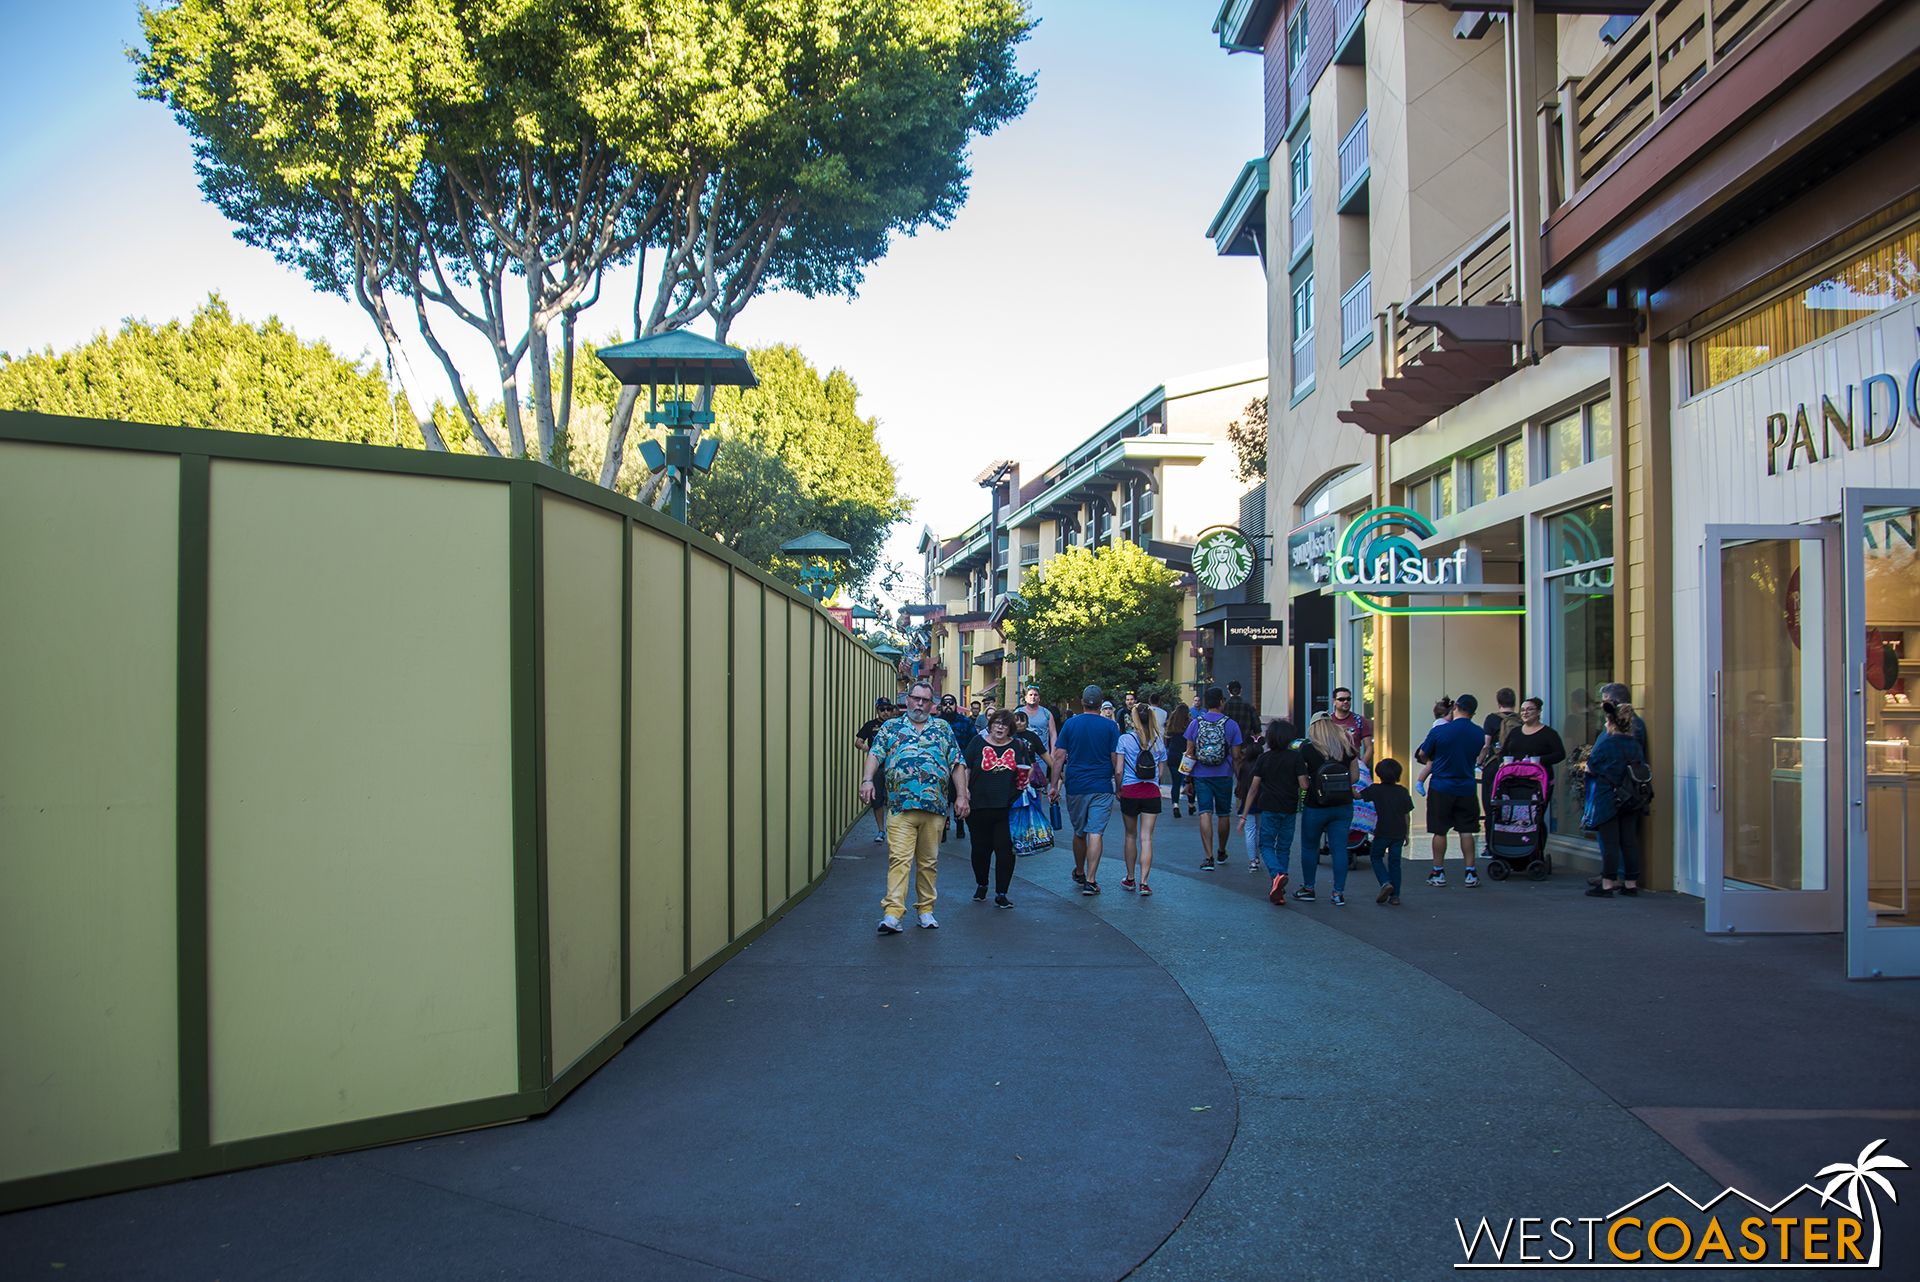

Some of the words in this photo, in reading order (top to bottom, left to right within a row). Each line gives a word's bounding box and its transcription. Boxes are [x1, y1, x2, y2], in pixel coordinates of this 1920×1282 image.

[1335, 547, 1396, 585] curl
[1402, 548, 1468, 585] surf
[1230, 626, 1261, 636] sunglass
[1262, 626, 1278, 634] icon
